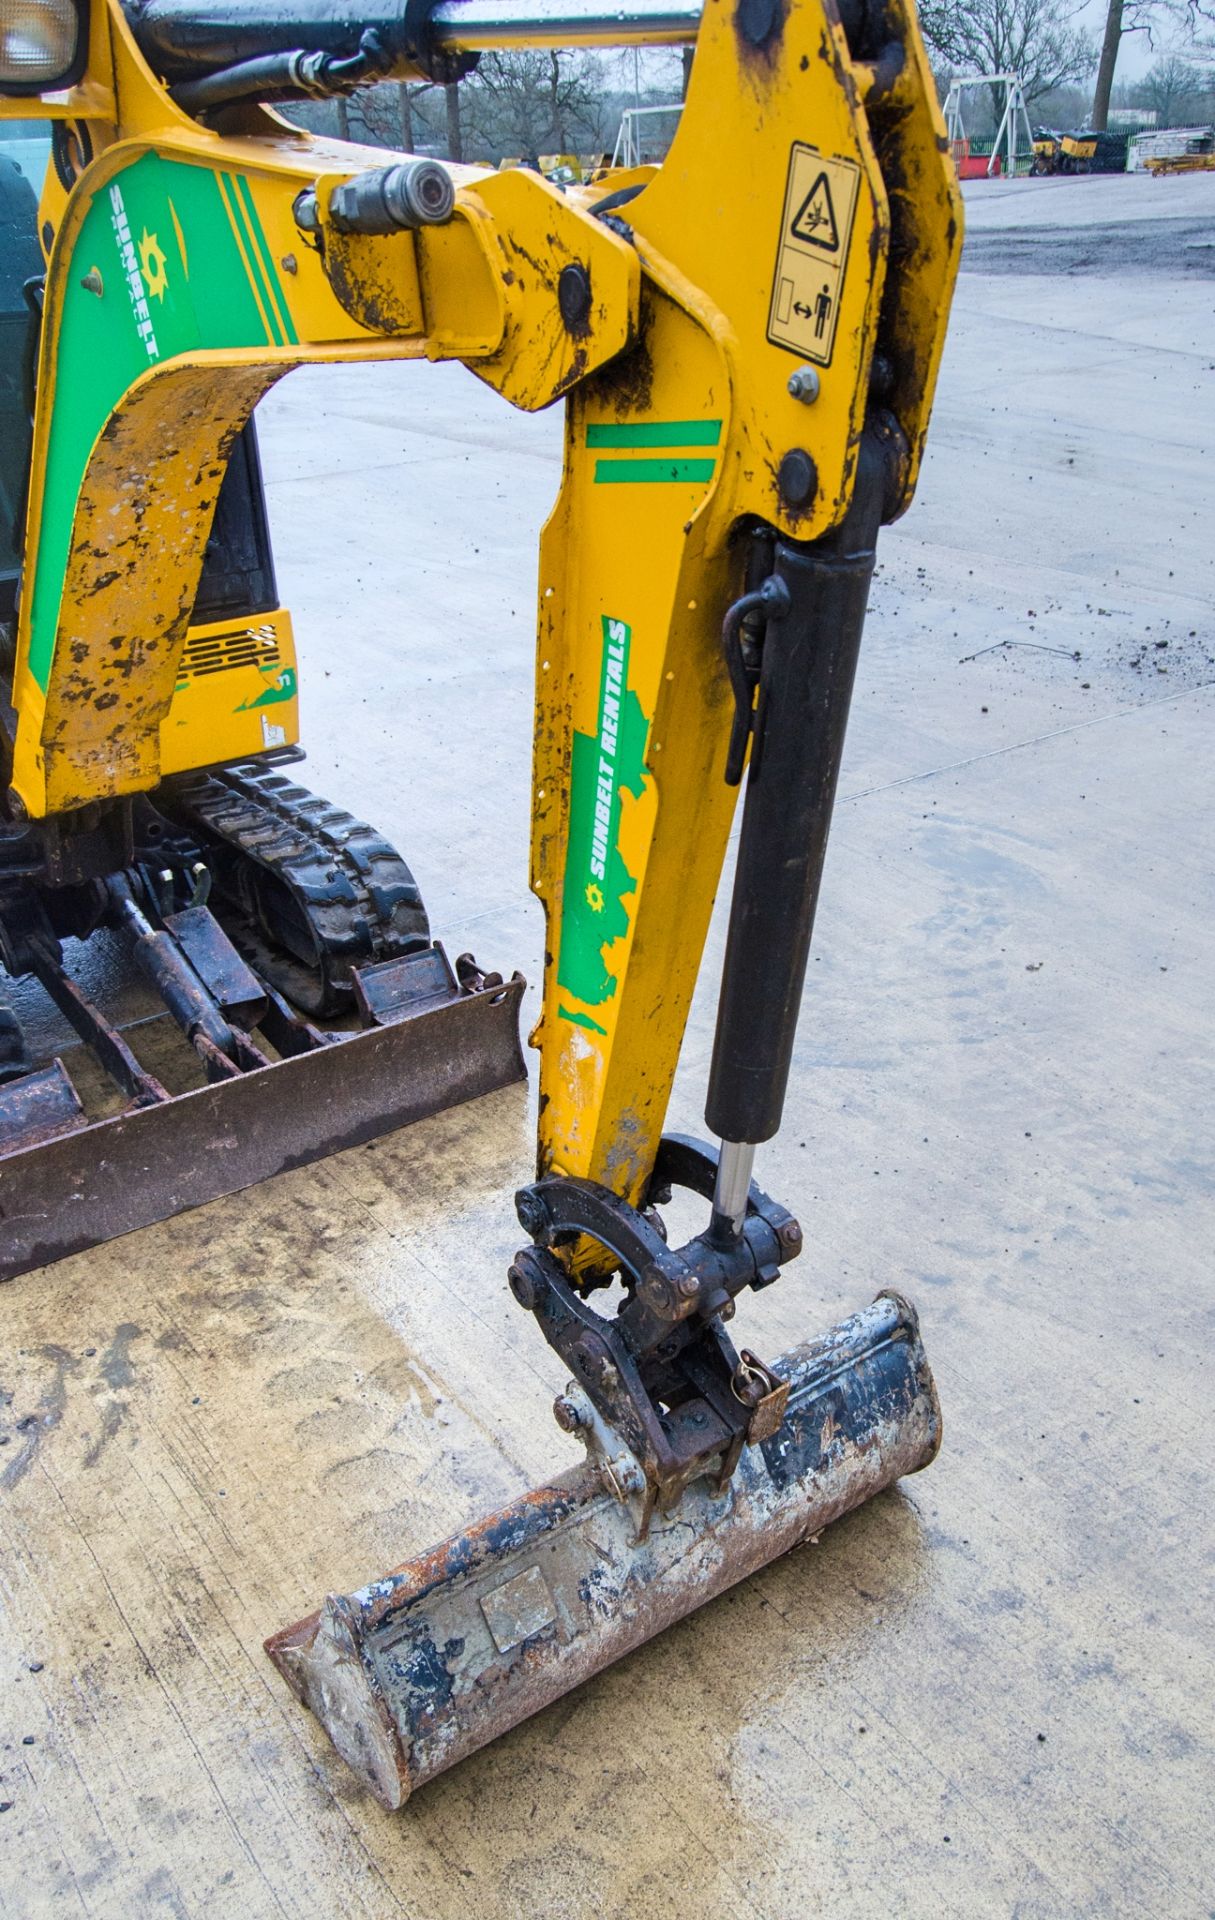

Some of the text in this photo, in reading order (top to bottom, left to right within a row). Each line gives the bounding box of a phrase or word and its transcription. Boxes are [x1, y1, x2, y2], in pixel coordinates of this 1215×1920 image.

[109, 184, 160, 358] SUNBELT
[110, 215, 143, 339] RENTALS
[590, 619, 626, 881] SUNBELT RENTALS
